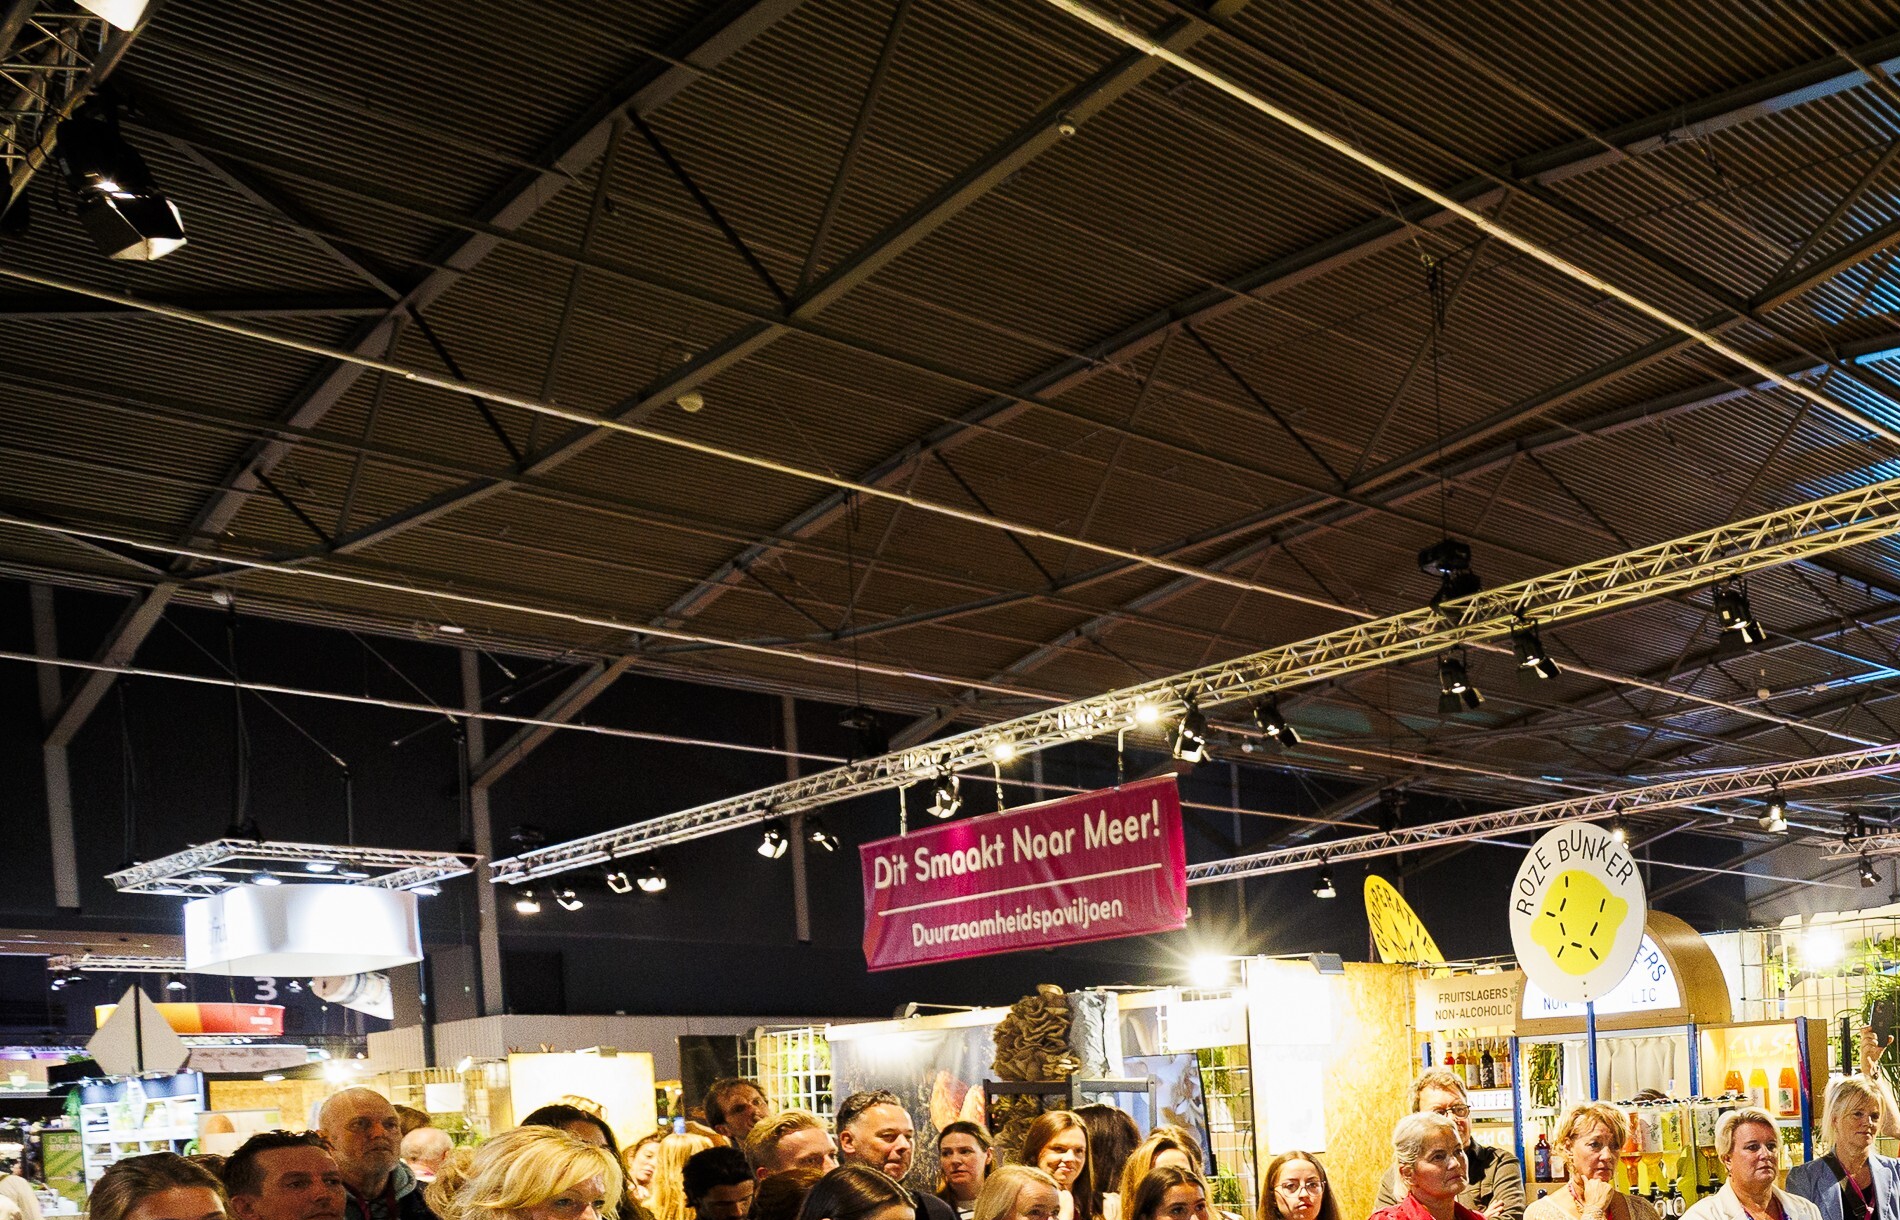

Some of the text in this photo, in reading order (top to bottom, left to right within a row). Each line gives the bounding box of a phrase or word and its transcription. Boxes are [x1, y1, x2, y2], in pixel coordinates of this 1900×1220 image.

[873, 797, 1161, 890] Dit Smaakt Naar Meer!
[1516, 828, 1634, 916] ROZE BUNKER
[911, 898, 1124, 949] Duurzaamheidspaviljoen
[252, 975, 279, 1002] 3
[1438, 987, 1509, 1004] FRUITSLAGERS
[1434, 1004, 1513, 1021] NON-ALCOHOLIC
